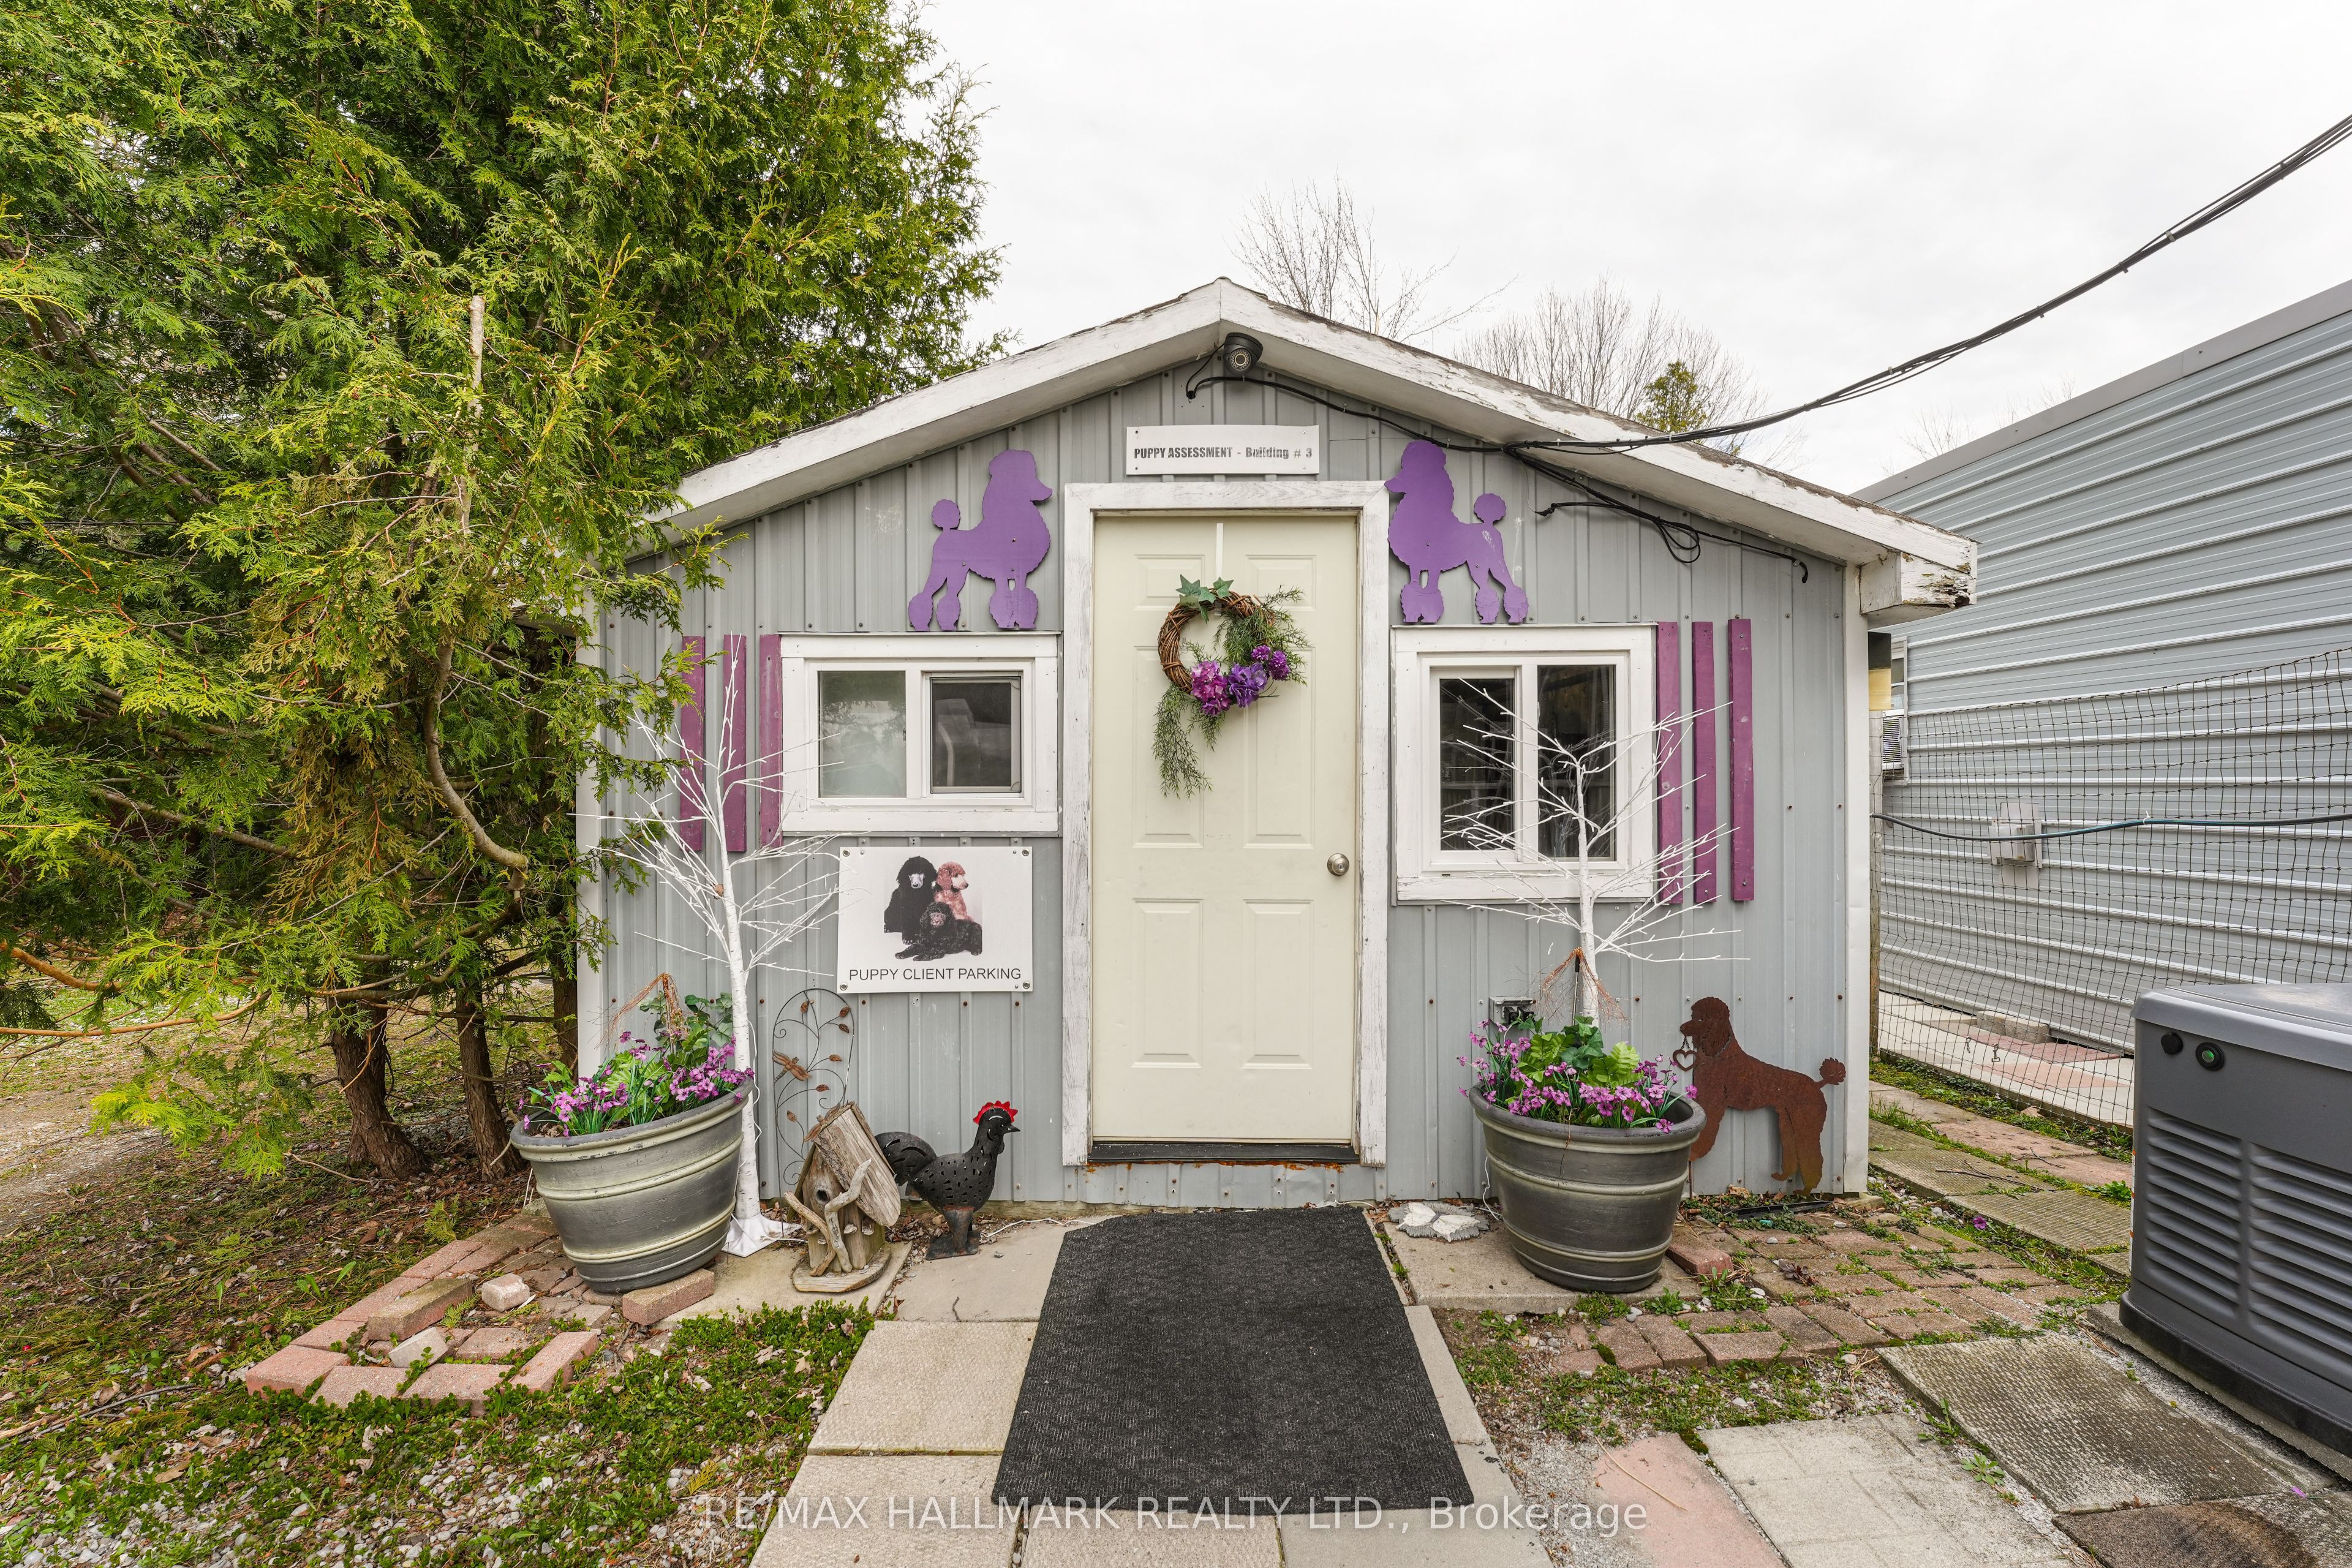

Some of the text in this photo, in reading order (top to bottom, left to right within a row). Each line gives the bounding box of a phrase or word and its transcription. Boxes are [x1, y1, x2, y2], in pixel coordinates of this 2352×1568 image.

[1134, 448, 1166, 459] PUPPY
[1167, 447, 1233, 458] ASSESSMENT
[1246, 447, 1289, 459] Building
[1294, 448, 1301, 458] #
[1306, 448, 1312, 458] 3
[849, 968, 1021, 981] PUPPY CLIENT PARKING
